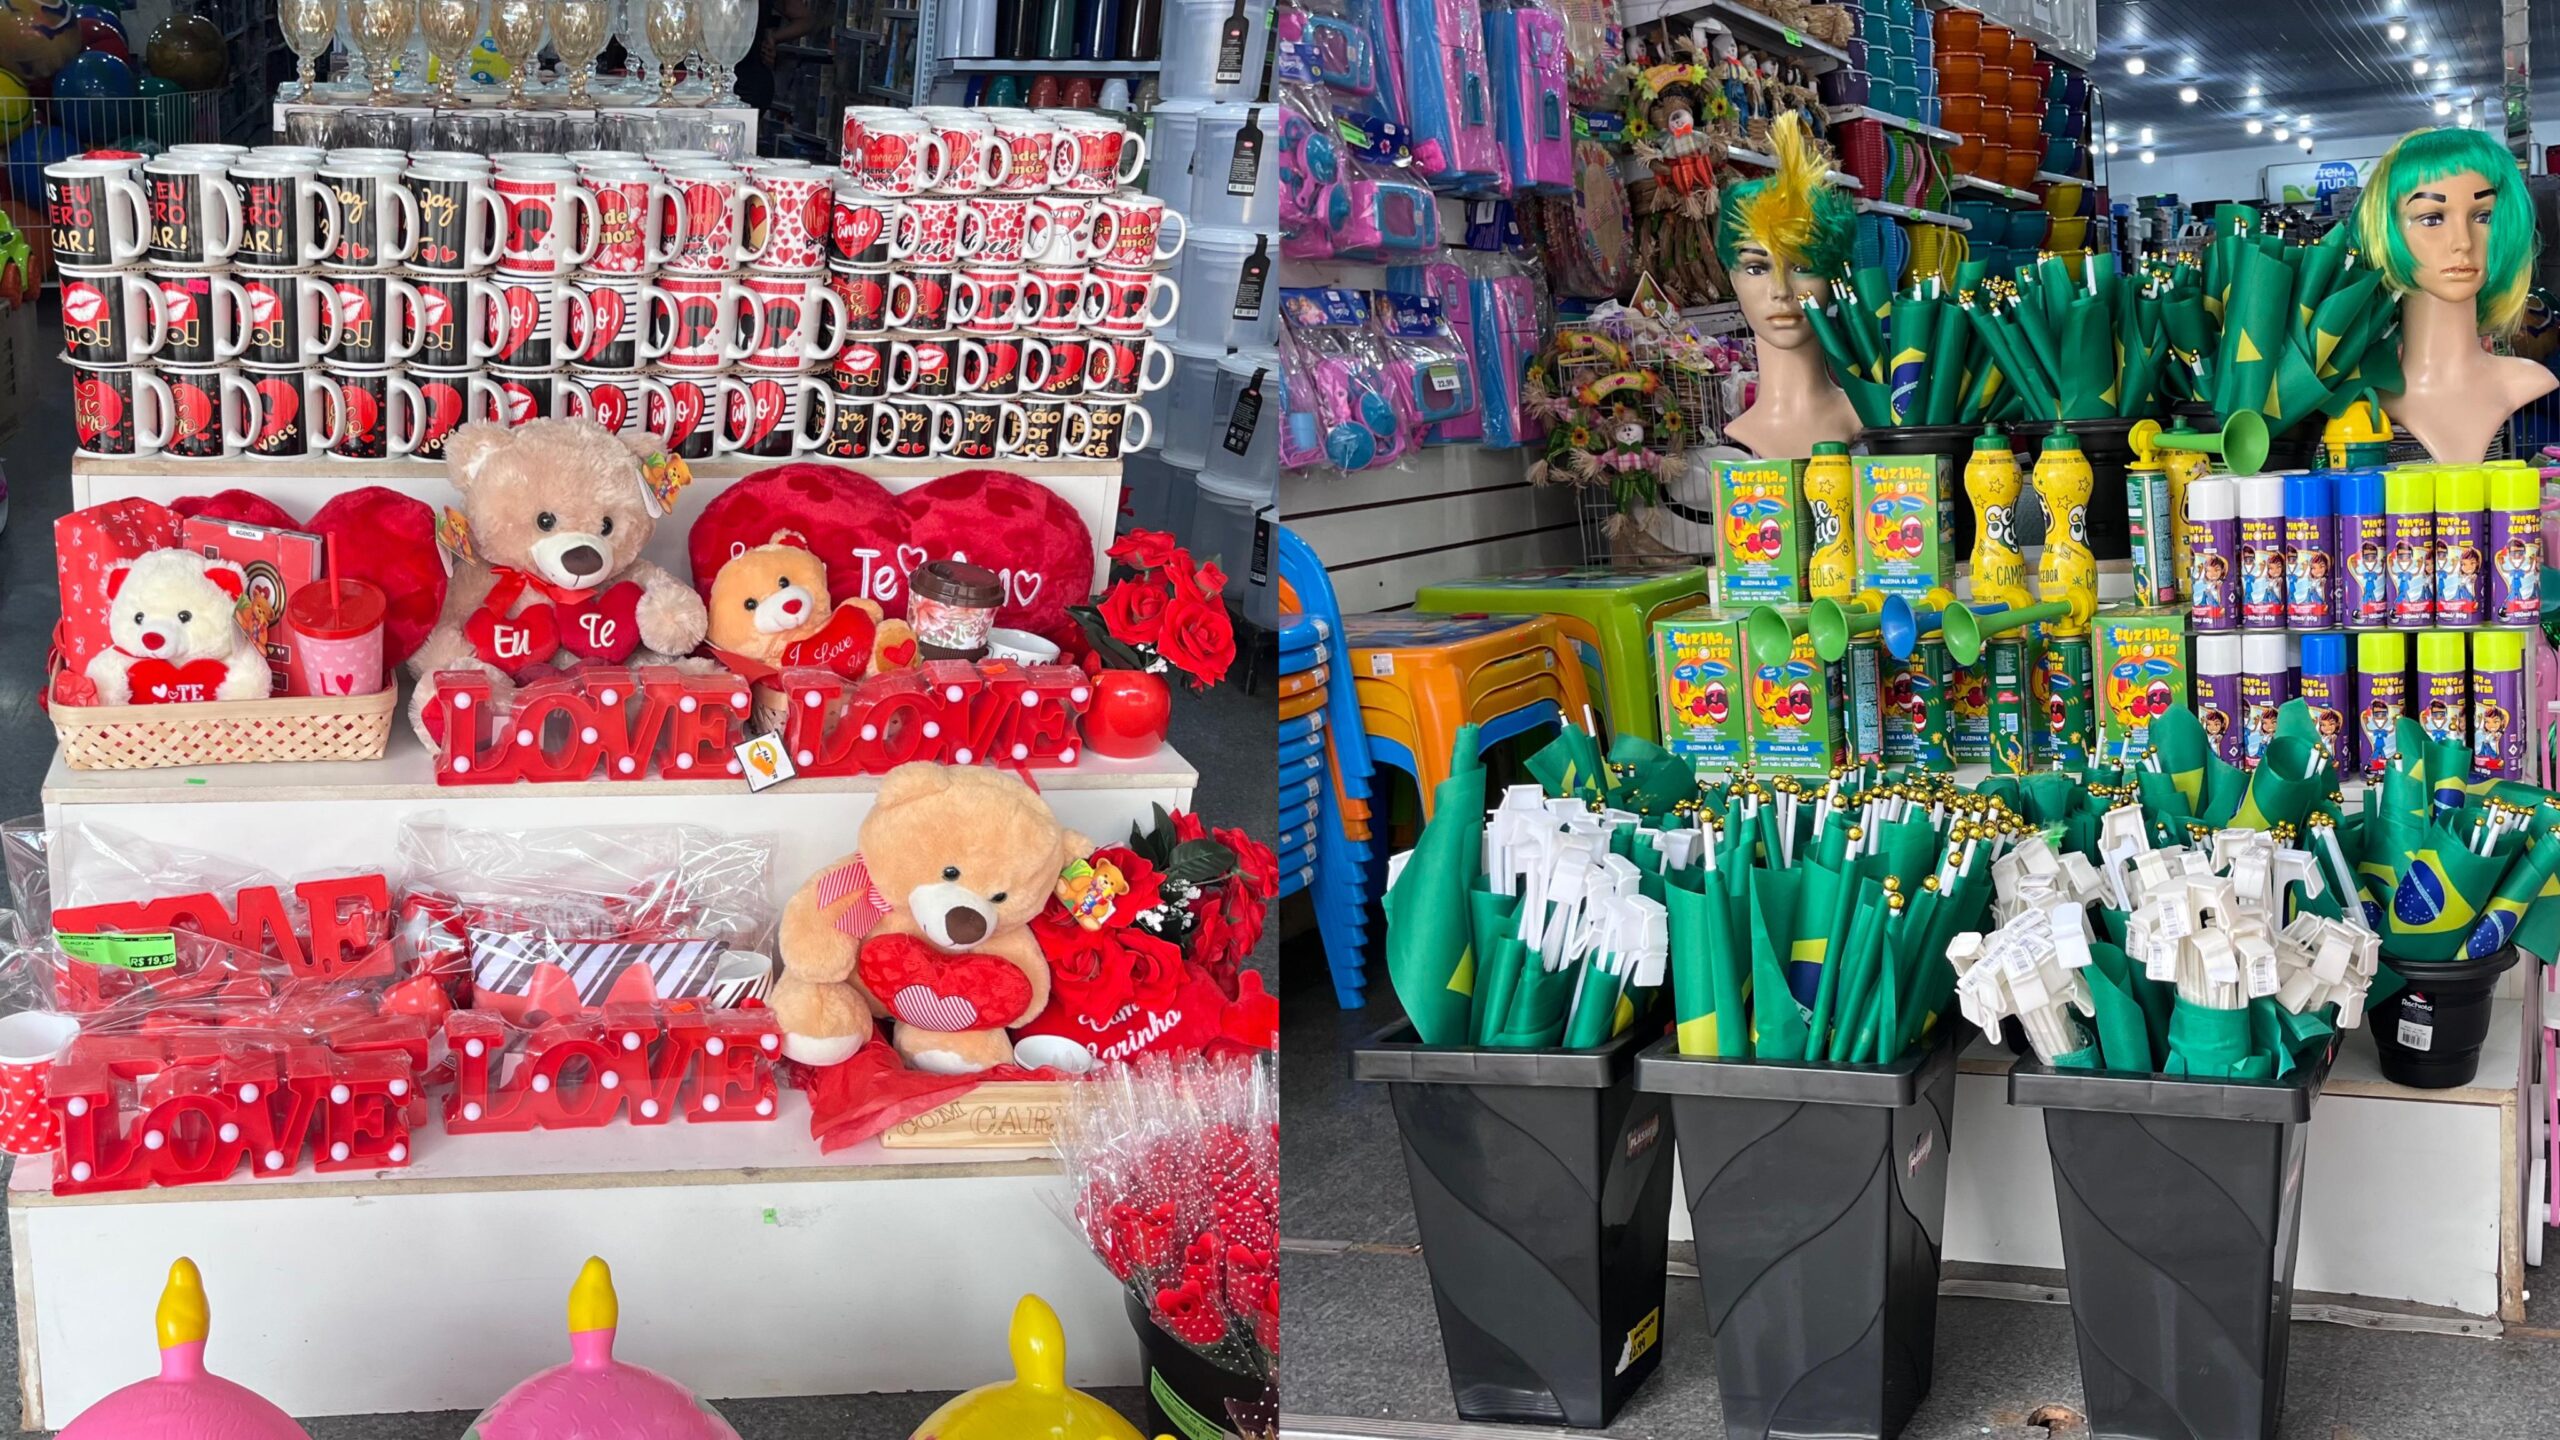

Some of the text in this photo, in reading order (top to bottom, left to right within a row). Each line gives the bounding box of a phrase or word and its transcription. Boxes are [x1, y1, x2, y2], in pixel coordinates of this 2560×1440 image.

[61, 184, 91, 204] EU
[156, 181, 186, 201] EU
[251, 185, 283, 205] EU
[50, 206, 93, 228] ERO
[834, 211, 847, 224] Te
[52, 228, 95, 253] CAR!
[151, 226, 187, 250] AR!
[241, 229, 284, 254] AR!
[64, 319, 111, 348] mo!
[166, 319, 200, 348] o!
[251, 319, 285, 348] o!
[340, 319, 373, 348] o!
[424, 322, 454, 351] o!
[836, 367, 881, 387] mo!
[421, 428, 457, 454] voc
[1012, 437, 1050, 457] ocê
[851, 547, 899, 601] Te
[1810, 566, 1835, 588] EÕES
[1996, 564, 2027, 587] CAMP
[2038, 568, 2059, 583] CEDOR
[493, 624, 532, 659] Eu
[579, 612, 616, 649] Te
[176, 683, 205, 702] TE
[436, 682, 752, 786] LOVE
[788, 678, 1093, 778] LOVE
[130, 954, 176, 967] R$ 19,99
[447, 1025, 783, 1136] LOVE
[897, 1100, 968, 1138] COM
[968, 1103, 1065, 1137] CAR
[50, 1076, 412, 1197] LOVE
